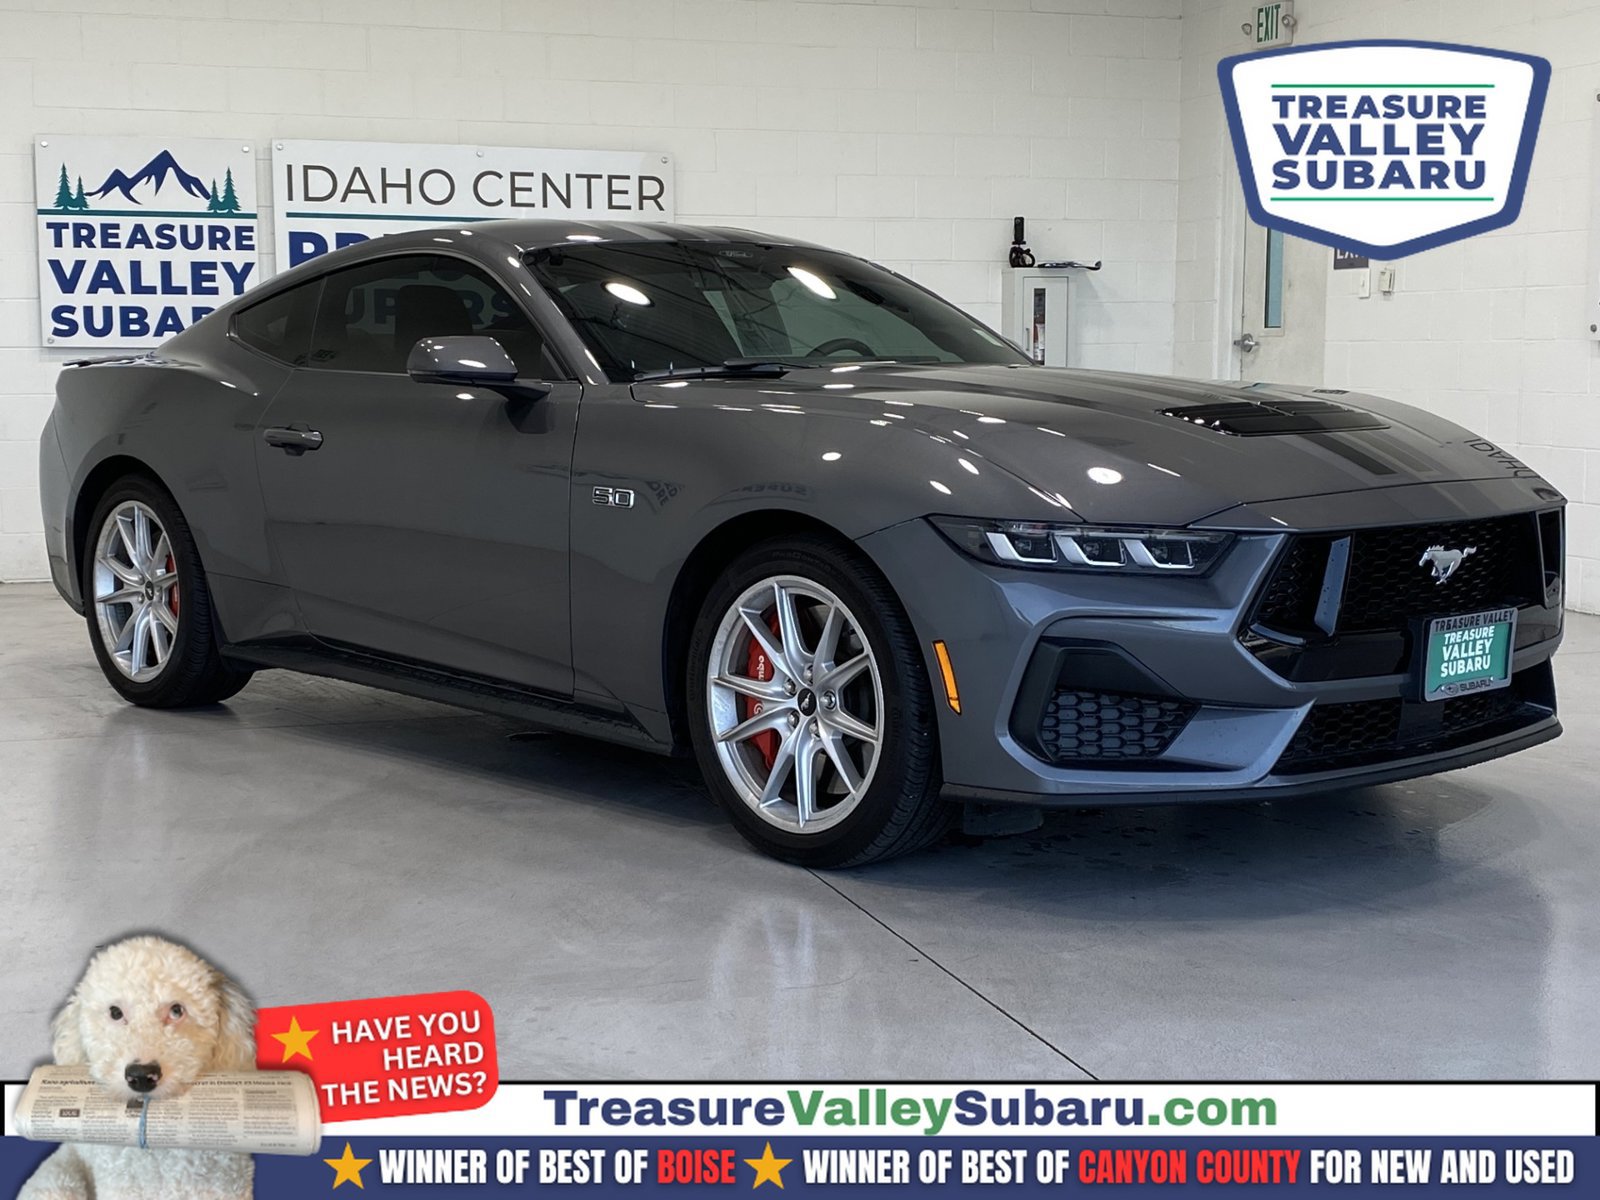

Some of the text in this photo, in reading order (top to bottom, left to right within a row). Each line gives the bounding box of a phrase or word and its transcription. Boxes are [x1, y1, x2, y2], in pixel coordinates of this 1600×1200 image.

[1257, 3, 1281, 43] EXIT
[286, 164, 666, 212] IDAHO CENTER
[46, 221, 256, 251] TREASURE
[47, 259, 256, 296] VALLEY
[1435, 609, 1515, 632] TREASURE VALLEY
[1444, 626, 1495, 645] TREASURE
[1442, 638, 1493, 661] VALLEY
[1441, 655, 1491, 678] SUBARU
[1460, 679, 1492, 692] SUBARU
